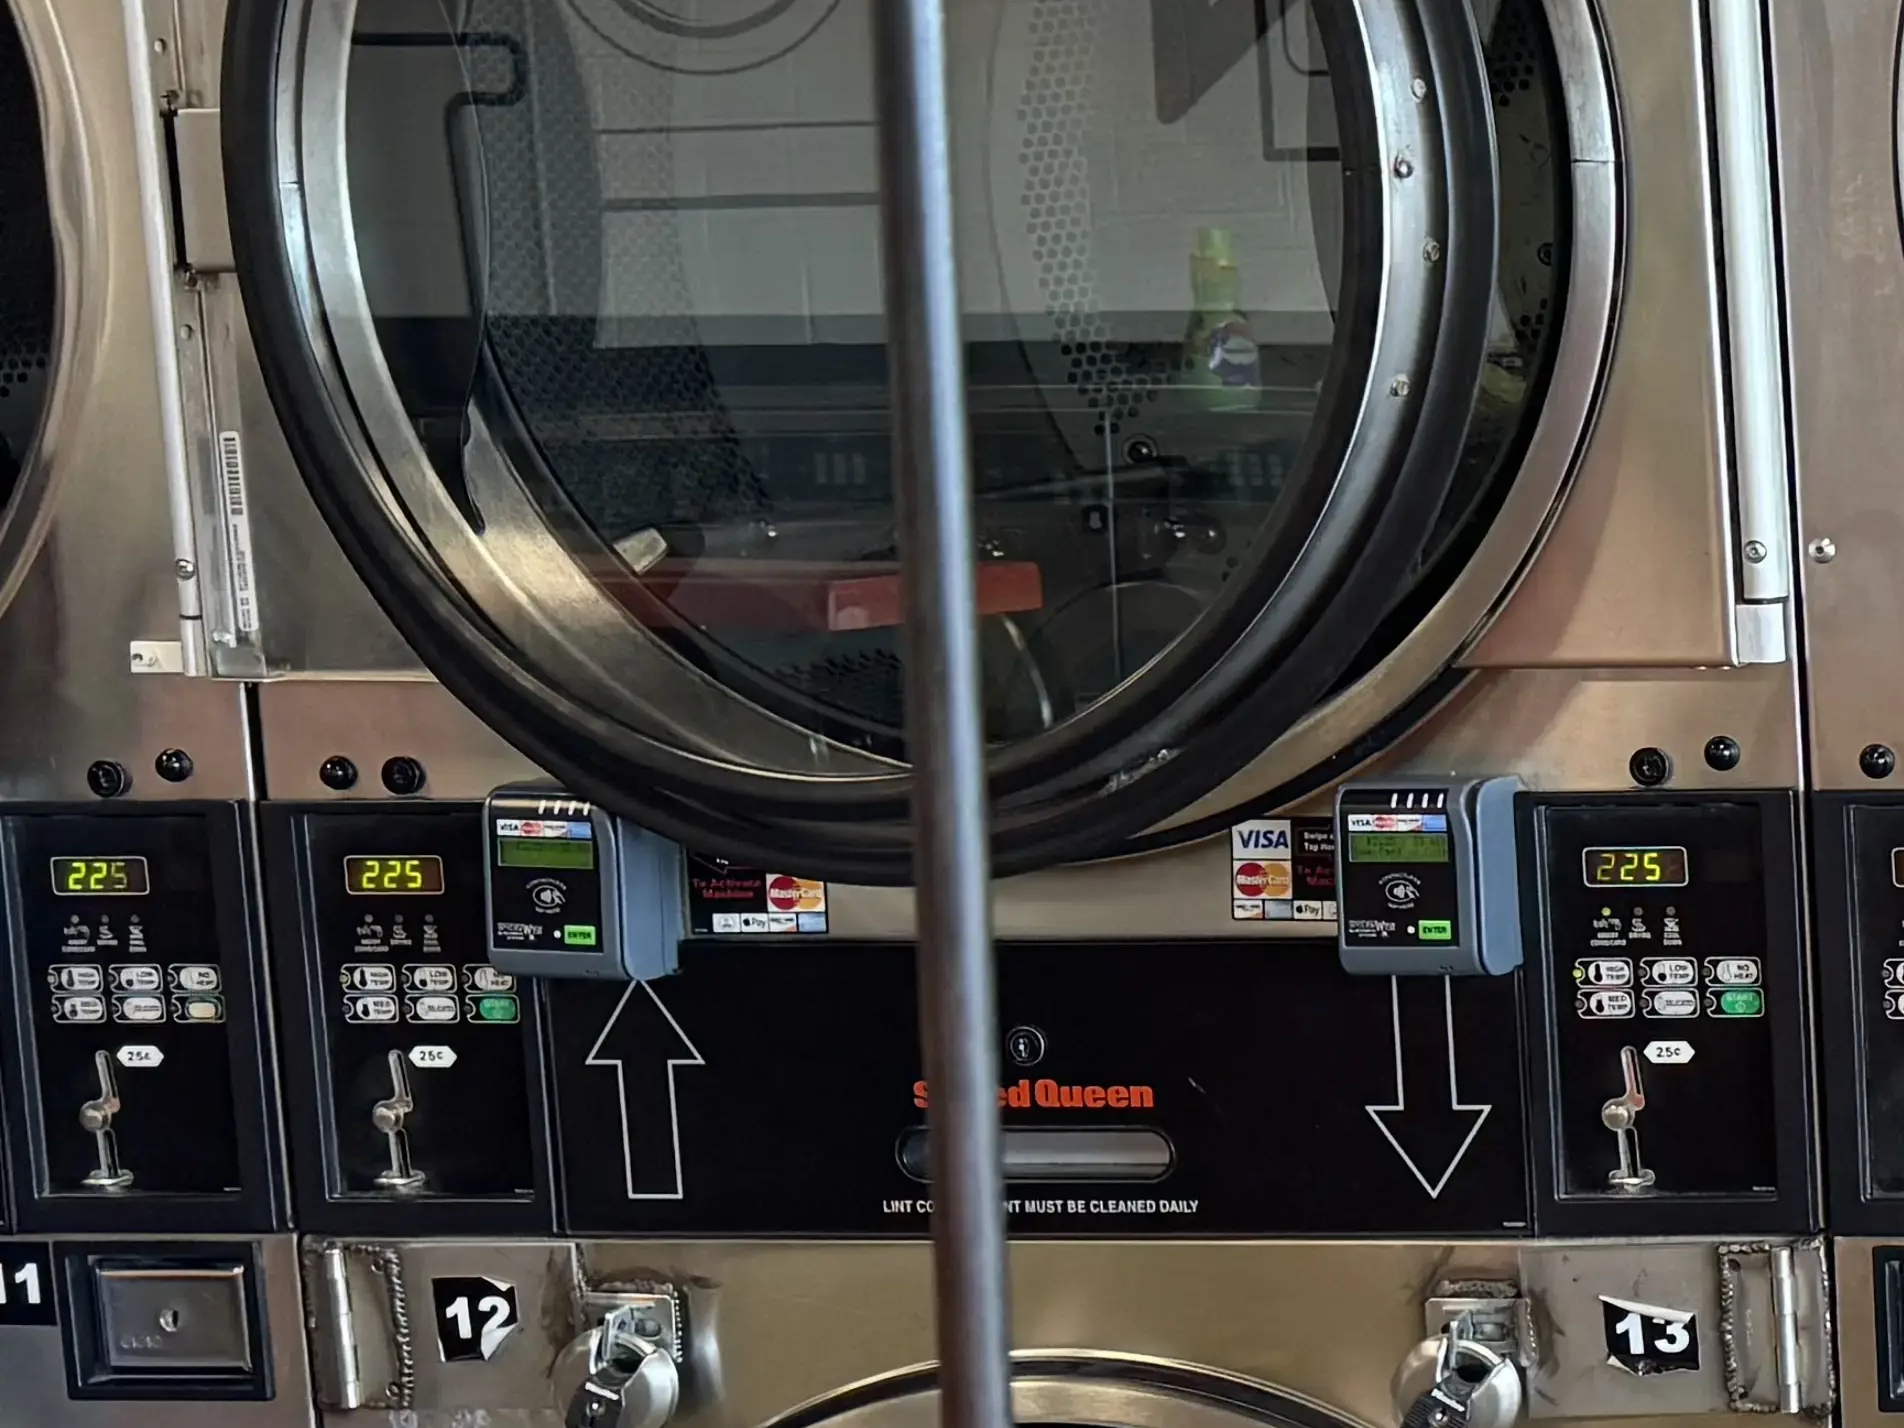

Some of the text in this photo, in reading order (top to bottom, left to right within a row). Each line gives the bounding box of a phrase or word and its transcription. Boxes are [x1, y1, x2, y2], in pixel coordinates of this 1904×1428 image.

[1238, 830, 1288, 848] VISA
[68, 862, 127, 890] 225
[362, 860, 422, 888] 225
[1597, 853, 1661, 881] 225
[1035, 1079, 1153, 1108] Queen
[883, 1200, 913, 1213] LINT
[1025, 1200, 1062, 1213] MUST
[1068, 1200, 1086, 1213] BE
[1090, 1200, 1155, 1213] CLEANED
[1159, 1200, 1198, 1213] DAILY
[446, 1296, 510, 1340] 12
[1616, 1313, 1689, 1354] 13
